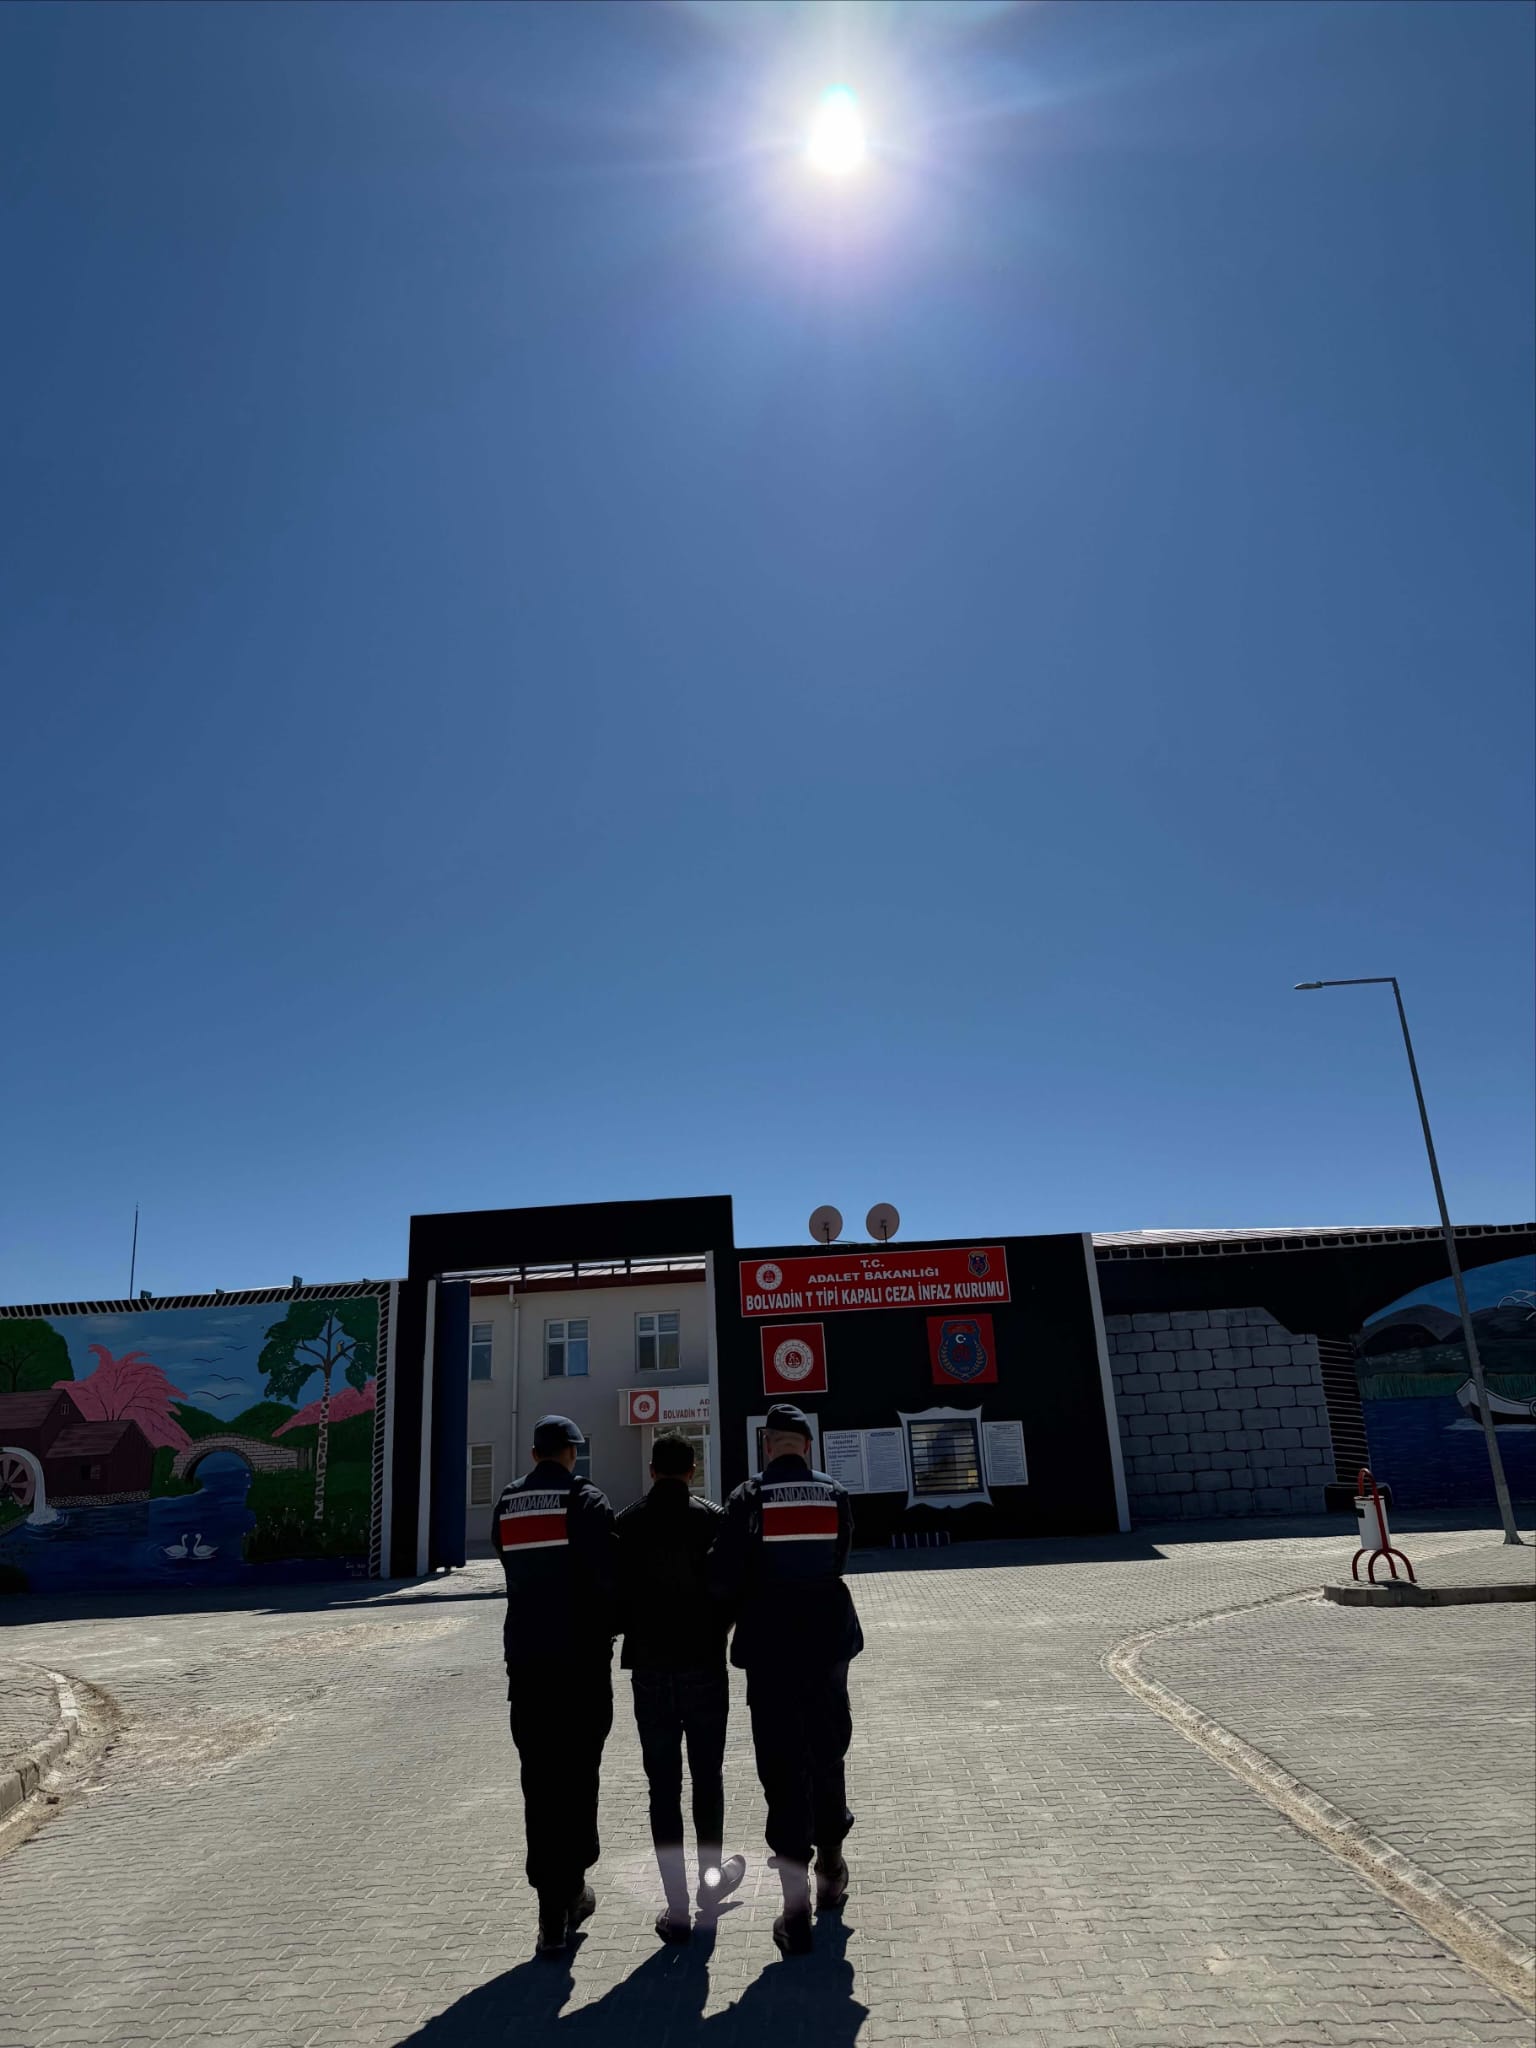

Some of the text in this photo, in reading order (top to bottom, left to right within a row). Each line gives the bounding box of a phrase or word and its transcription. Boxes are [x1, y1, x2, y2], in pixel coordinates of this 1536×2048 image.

[860, 1259, 885, 1269] T.C.
[807, 1267, 939, 1284] ADALET BAKANLIĞI
[746, 1281, 1004, 1311] BOLVADİN T TİPİ KAPALI CEZA İNFAZ KURUMU
[770, 1487, 832, 1503] JANDARMA
[505, 1494, 561, 1514] JANDARMA
